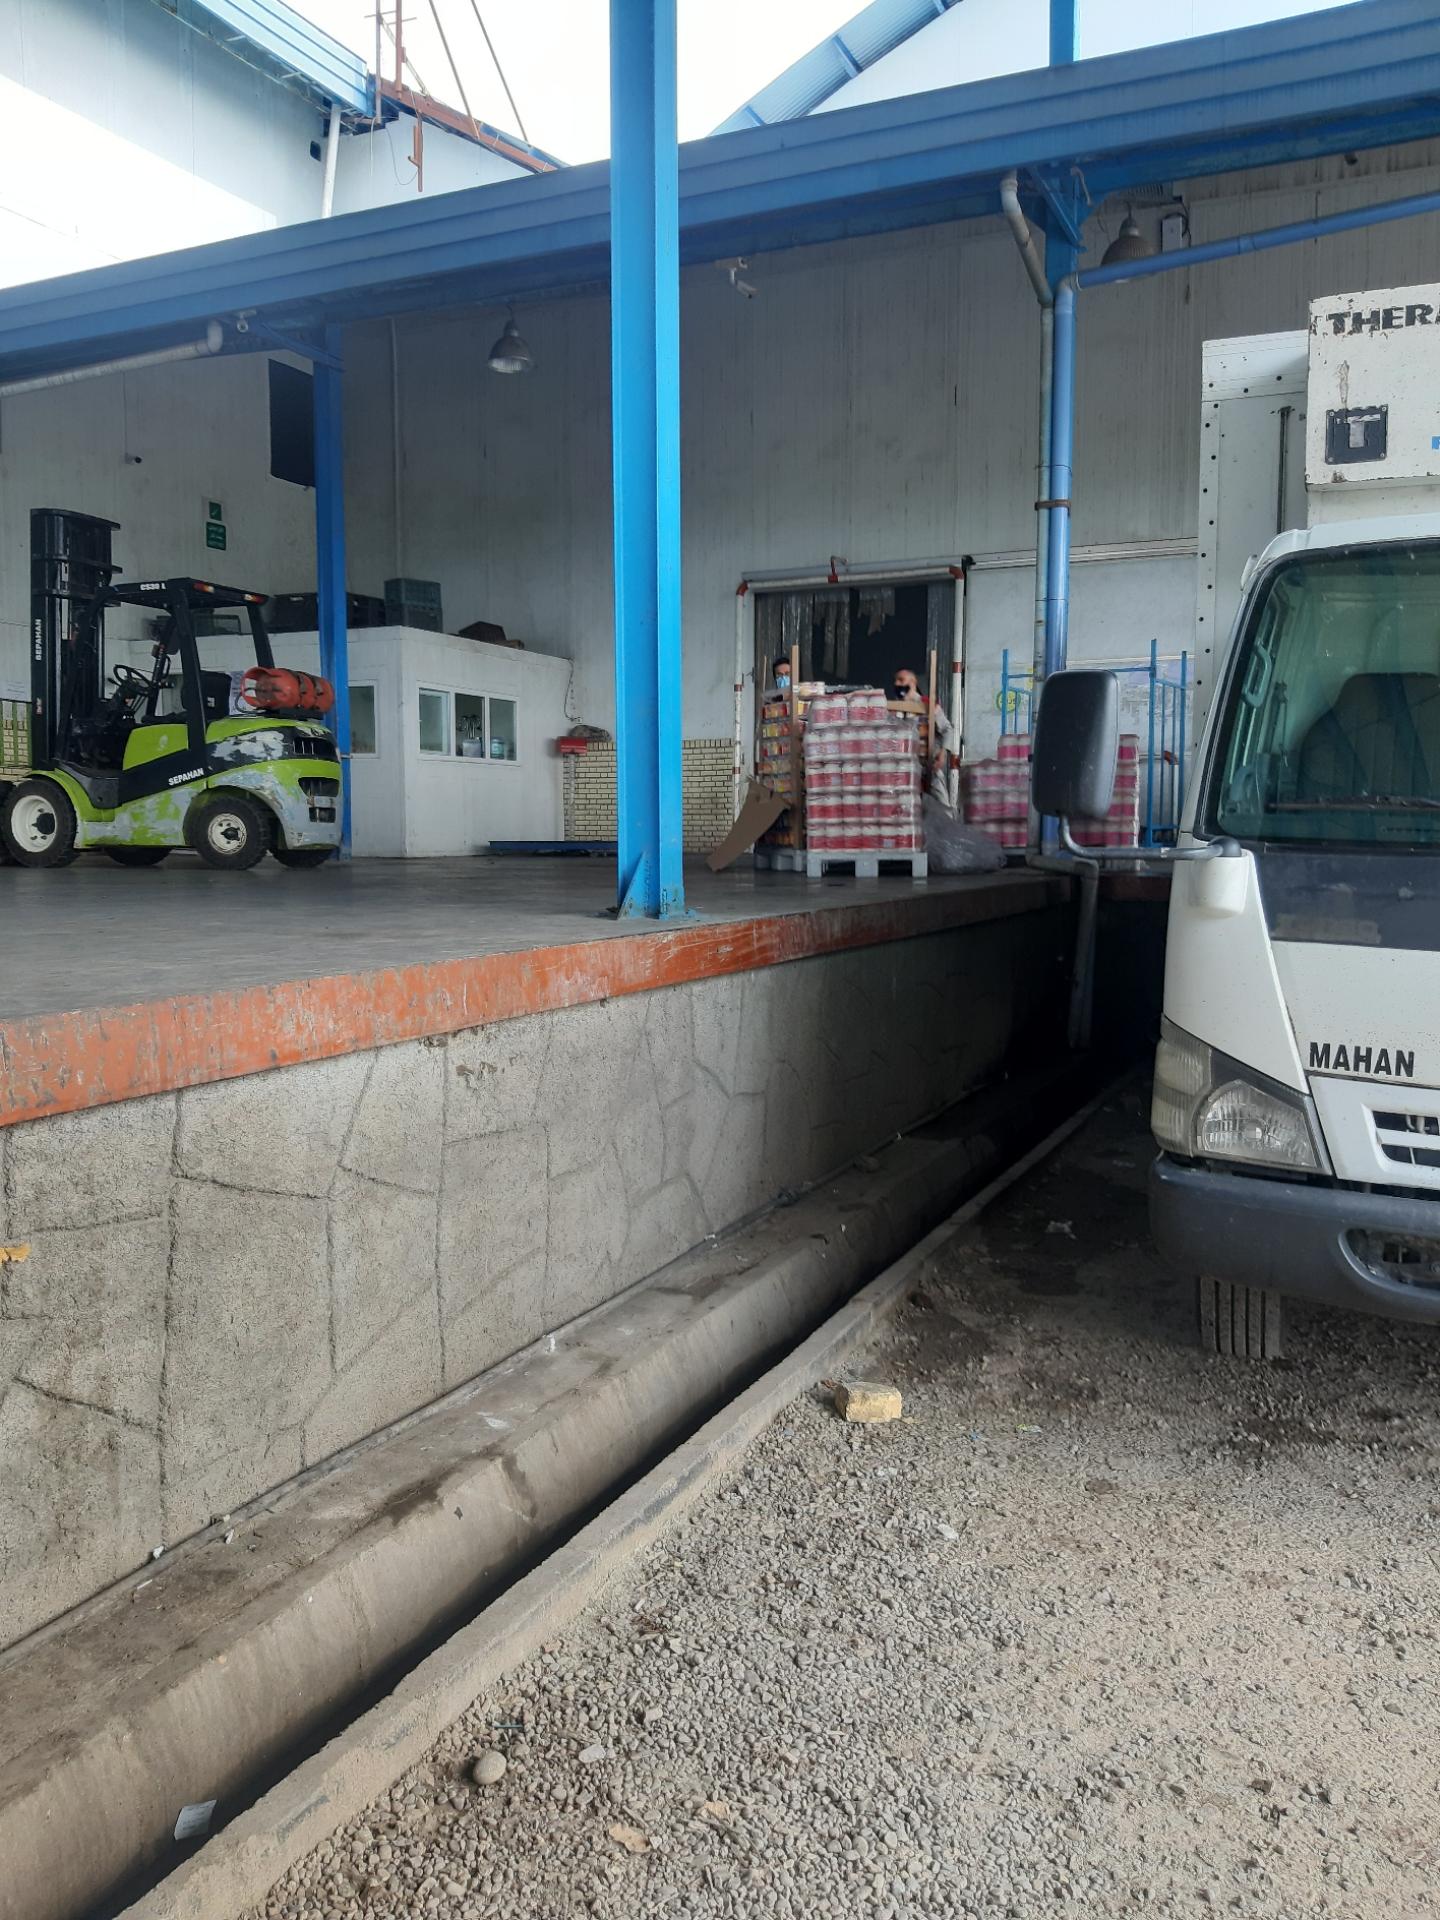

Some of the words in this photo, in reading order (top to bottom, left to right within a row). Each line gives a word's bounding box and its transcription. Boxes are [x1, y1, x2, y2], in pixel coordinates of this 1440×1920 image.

[1327, 304, 1440, 335] THER
[168, 767, 205, 786] SEPAHAN
[1309, 1042, 1415, 1077] MAHAN
